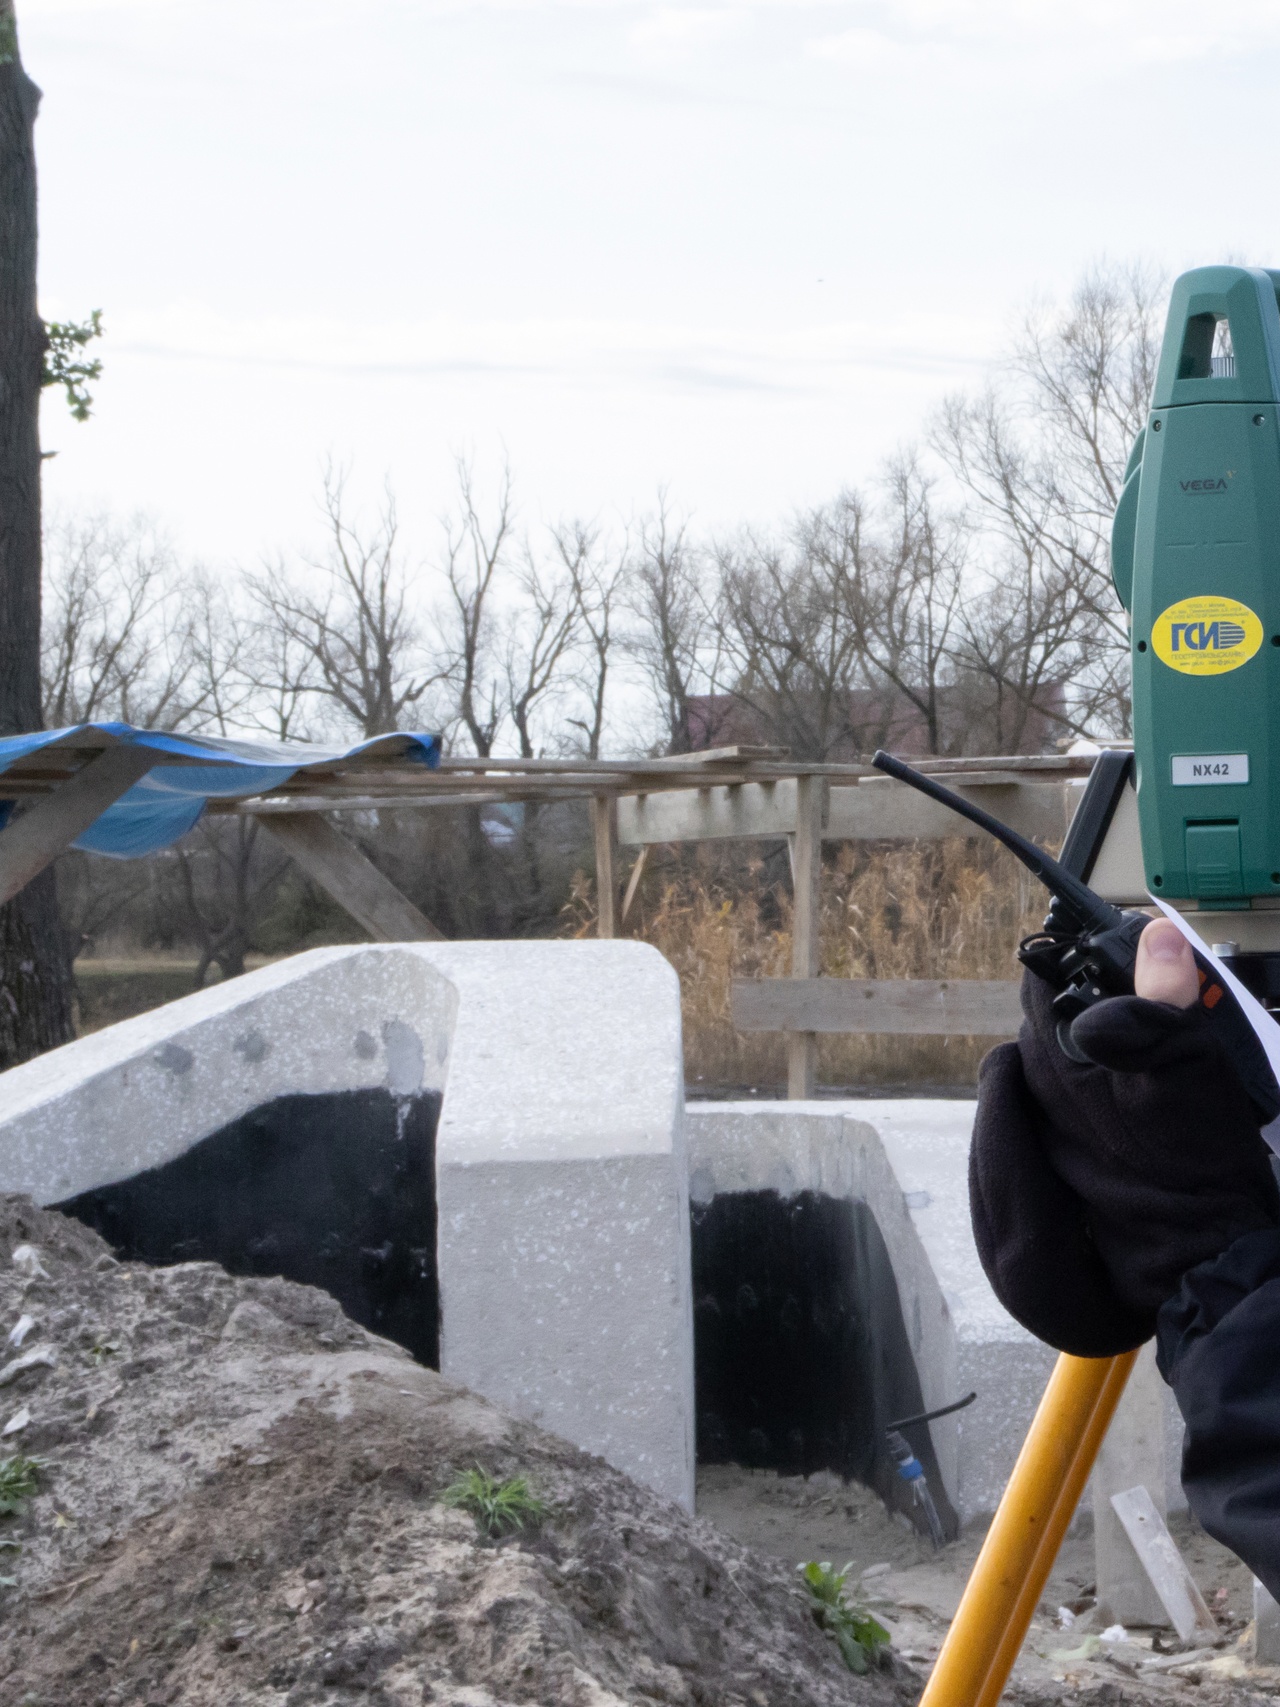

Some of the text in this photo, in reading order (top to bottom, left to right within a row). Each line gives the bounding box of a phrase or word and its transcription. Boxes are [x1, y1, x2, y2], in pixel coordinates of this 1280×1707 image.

[1179, 478, 1228, 491] VEGA
[1171, 622, 1220, 651] ГСИ
[1193, 763, 1229, 776] NX42
